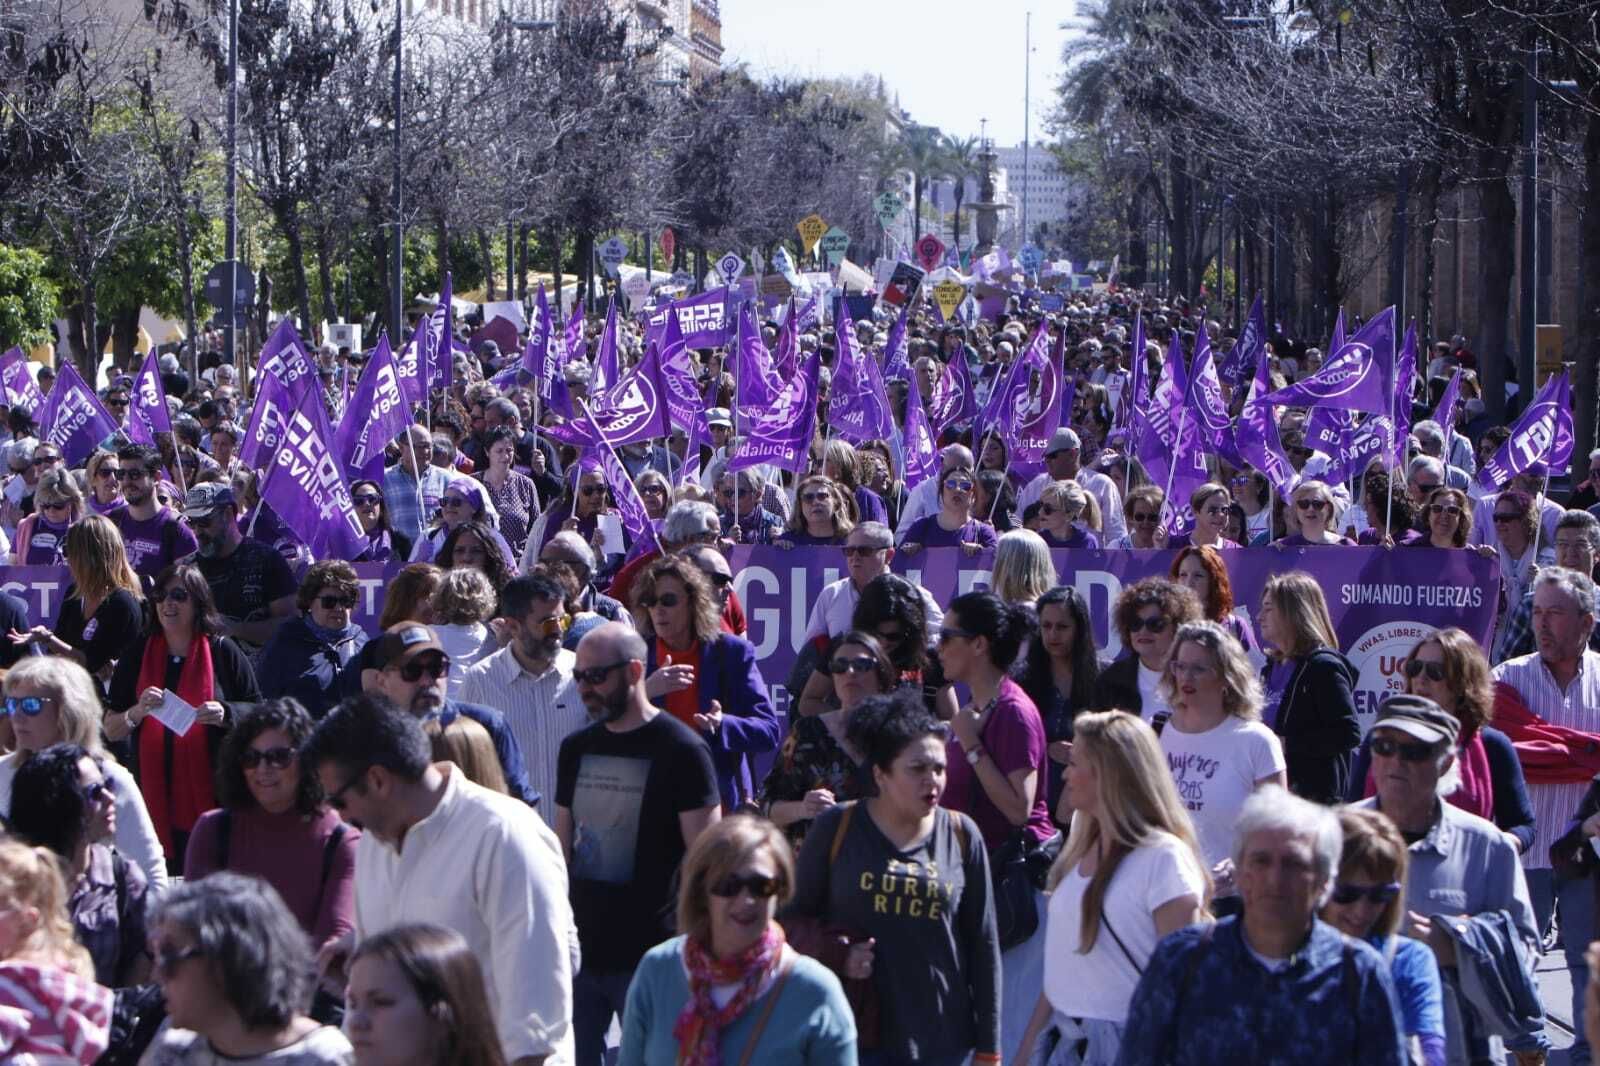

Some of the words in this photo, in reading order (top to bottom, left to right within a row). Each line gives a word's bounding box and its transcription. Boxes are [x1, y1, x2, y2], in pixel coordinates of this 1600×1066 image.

[1342, 583, 1412, 605] SUMANDO
[1417, 585, 1482, 607] FUERZAS
[1359, 632, 1388, 654] VIVAS,
[860, 871, 953, 899] CURRY
[874, 894, 941, 921] RICE
